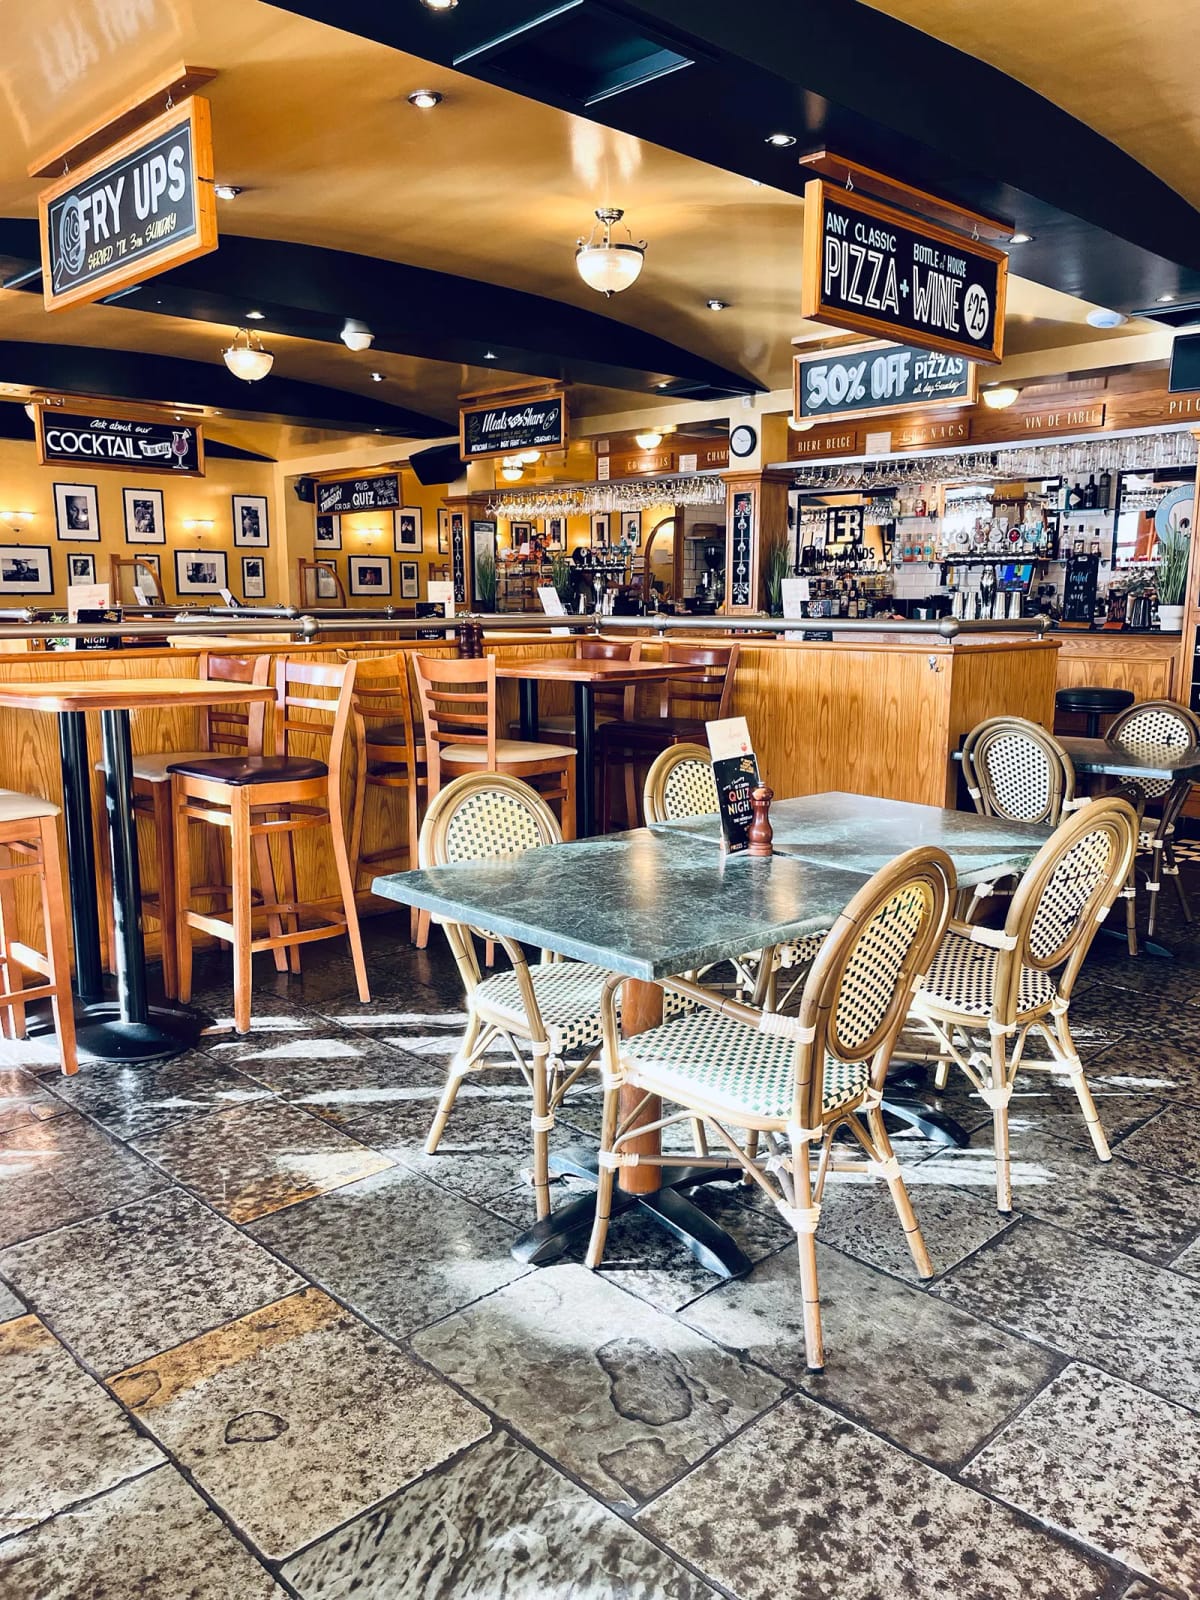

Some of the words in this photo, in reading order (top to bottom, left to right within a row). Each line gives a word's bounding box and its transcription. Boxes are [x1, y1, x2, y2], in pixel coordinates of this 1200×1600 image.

[77, 176, 124, 251] FRY
[133, 145, 186, 221] UPS
[88, 245, 113, 270] SERVED
[145, 212, 177, 242] SUNDAY
[826, 212, 849, 237] ANY
[855, 222, 897, 253] CLASSIC
[913, 243, 939, 268] BOTTLE
[947, 255, 967, 278] HOUSE
[824, 236, 900, 315] PIZZA
[912, 264, 963, 333] WINE
[805, 360, 867, 409] 50%
[870, 351, 912, 399] OFF
[914, 357, 963, 381] PIZZAS
[90, 419, 107, 430] Ask
[109, 420, 132, 433] about
[135, 426, 153, 434] our
[482, 411, 507, 433] Meals
[522, 407, 545, 427] Share
[1024, 416, 1041, 429] VIN
[1048, 414, 1060, 426] DE
[1067, 410, 1096, 424] TABLE
[46, 431, 142, 459] COCKTAIL
[798, 441, 822, 452] BIERE
[352, 491, 375, 506] QUIZ
[354, 481, 369, 491] PUB
[728, 787, 750, 802] QUIZ
